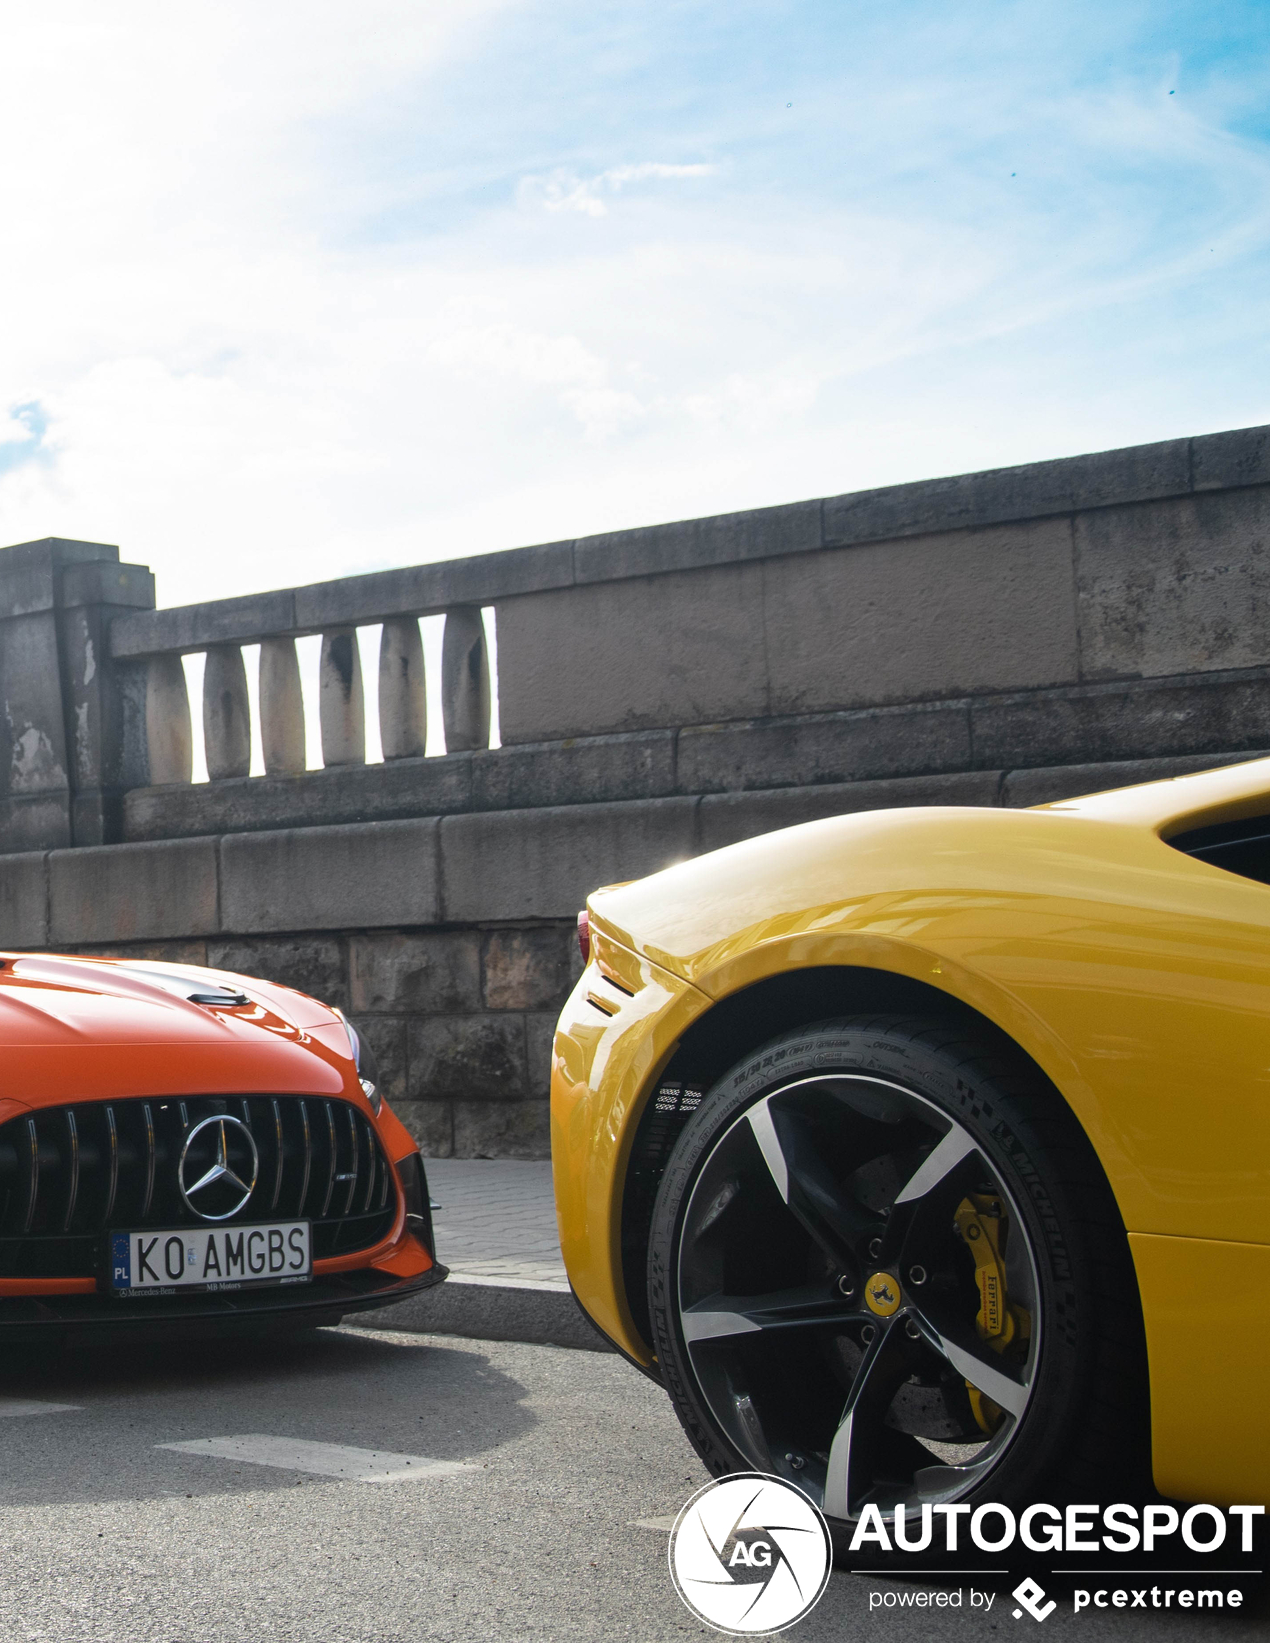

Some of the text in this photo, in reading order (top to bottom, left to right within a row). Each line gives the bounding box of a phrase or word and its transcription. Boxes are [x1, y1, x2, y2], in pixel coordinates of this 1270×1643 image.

[1011, 1151, 1072, 1280] MICHELIN
[114, 1267, 129, 1280] PL
[203, 1227, 305, 1278] AMGBS
[129, 1287, 176, 1298] Mercedes-Benz
[206, 1281, 241, 1292] MB Motors
[988, 1276, 999, 1330] Ferrari
[655, 1308, 698, 1426] MICHELIN
